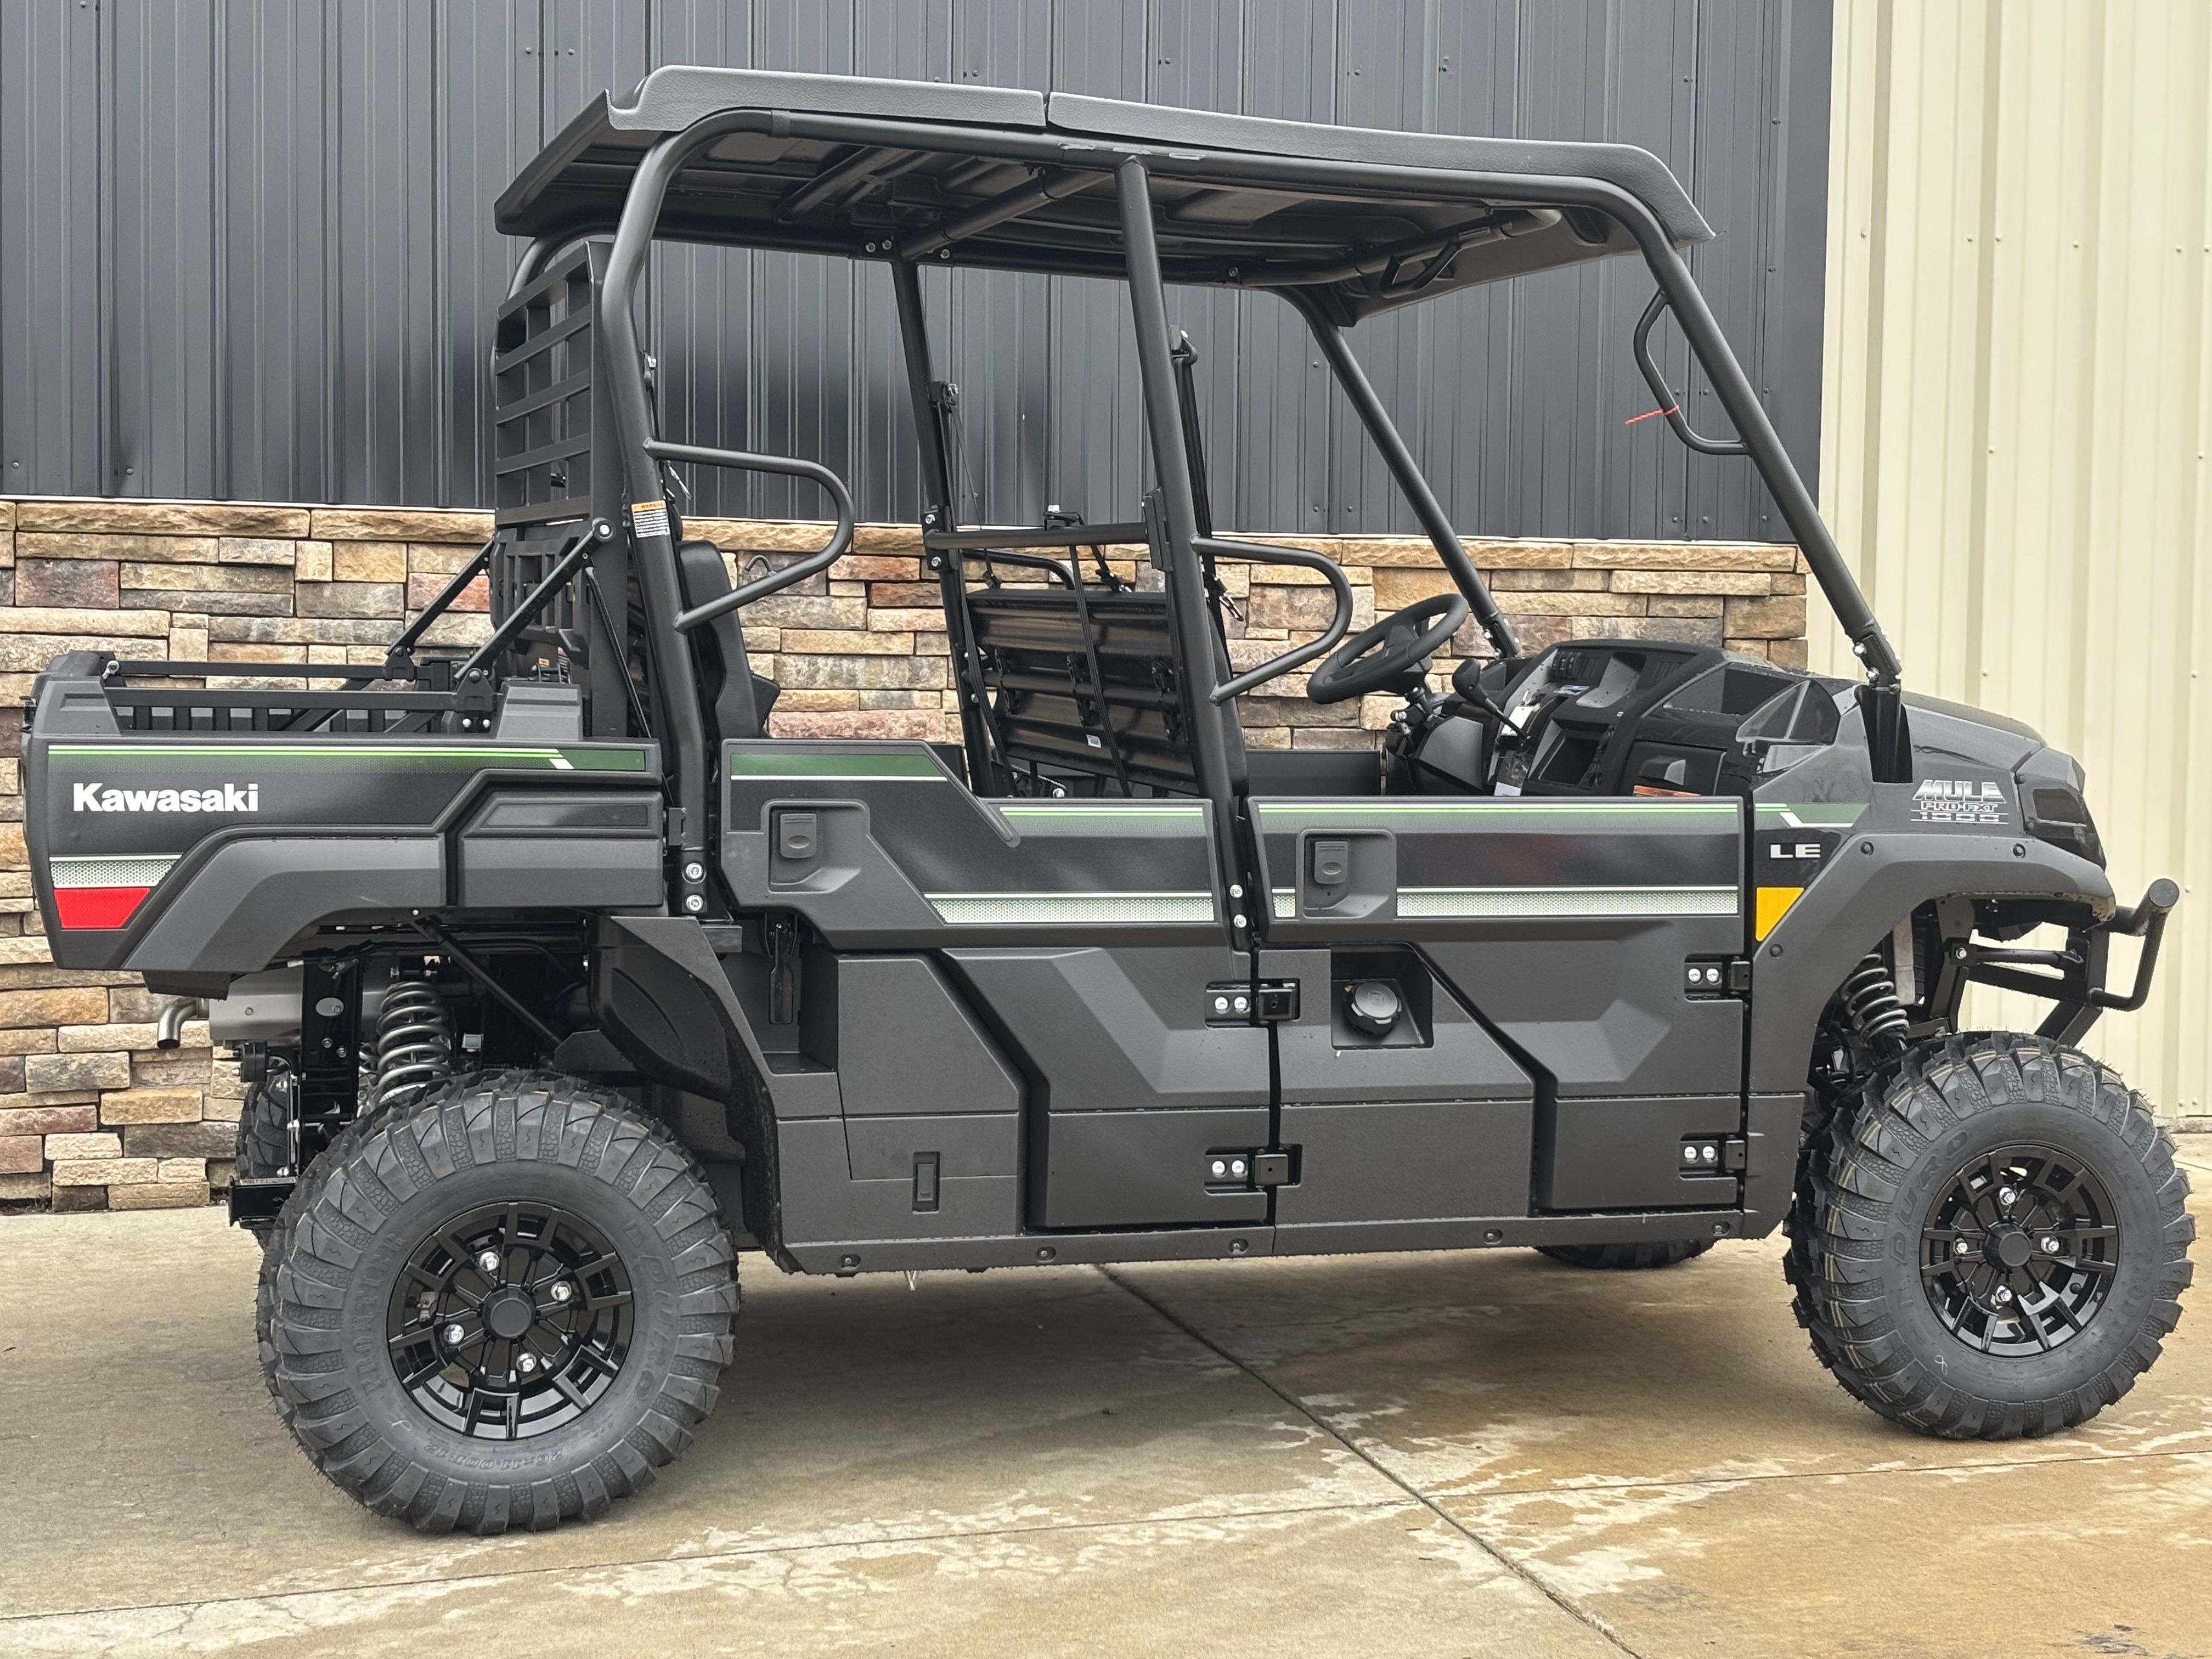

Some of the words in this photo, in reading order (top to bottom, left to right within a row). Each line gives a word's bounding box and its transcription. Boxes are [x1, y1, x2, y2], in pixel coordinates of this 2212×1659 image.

[74, 783, 258, 812] Kawasaki
[1912, 780, 2007, 803] MULE
[1920, 812, 1999, 822] 1000
[1770, 844, 1821, 859] LE
[1891, 1130, 1968, 1264] DURO
[635, 1255, 673, 1400] DURO
